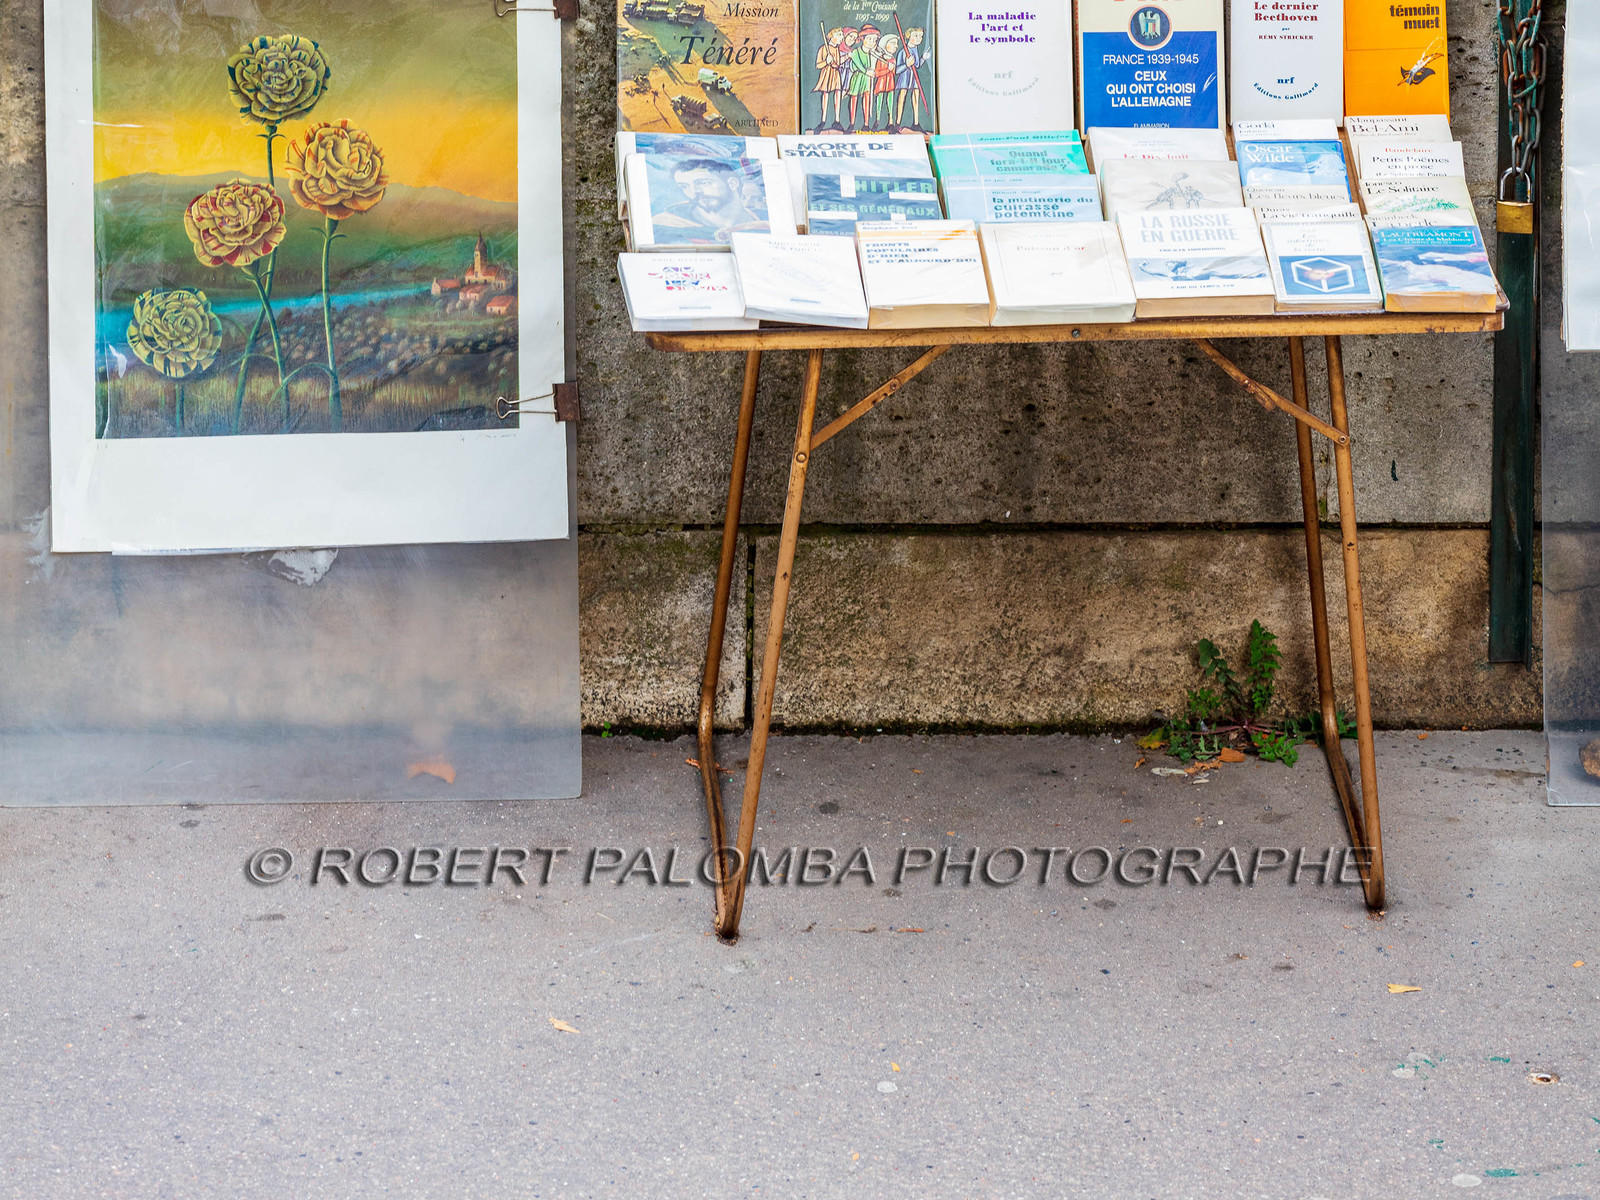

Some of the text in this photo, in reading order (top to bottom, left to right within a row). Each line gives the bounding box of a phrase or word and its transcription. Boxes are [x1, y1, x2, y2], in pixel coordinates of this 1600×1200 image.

[723, 2, 779, 18] Mission
[843, 2, 851, 11] de
[852, 2, 860, 11] la
[871, 1, 898, 12] Croisade
[1254, 1, 1319, 10] Le dernier
[1389, 3, 1440, 17] témoin
[855, 13, 870, 21] 1095
[875, 13, 890, 22] 1099
[968, 12, 1037, 21] La maladie
[1254, 12, 1318, 22] Beethoven
[981, 23, 1024, 32] l'art et
[1403, 16, 1440, 29] muet
[969, 34, 1036, 45] le symbole
[679, 36, 779, 66] Ténéré
[1102, 53, 1199, 65] FRANCE 1939-1945
[993, 70, 1014, 79] nrf
[1134, 70, 1167, 81] CEUX
[1277, 76, 1295, 84] nrf
[1002, 76, 1039, 96] Gallimard
[1106, 82, 1196, 95] QUI ONT CHOISI
[1284, 81, 1319, 100] Gallimard
[1111, 96, 1192, 107] L'ALLEMAGNE
[734, 119, 779, 128] ARTHAUD
[1351, 123, 1419, 133] Bel-Ami
[797, 142, 894, 151] MORT DE
[1245, 143, 1293, 153] Oscar
[784, 149, 866, 158] STALINE
[1009, 150, 1048, 158] Quand
[1246, 152, 1295, 163] Wilde
[996, 164, 1058, 172] camarade
[1249, 170, 1273, 182] Le
[855, 180, 934, 194] HITLER
[1368, 185, 1440, 195] Le Solitaire
[1273, 192, 1306, 200] fleurs
[1308, 192, 1345, 200] bleues
[828, 203, 856, 212] SES
[993, 203, 1060, 211] cuirassé
[994, 210, 1075, 219] potemkine
[1140, 213, 1233, 228] LA RUSSIE
[1140, 228, 1241, 242] EN GUERRE
